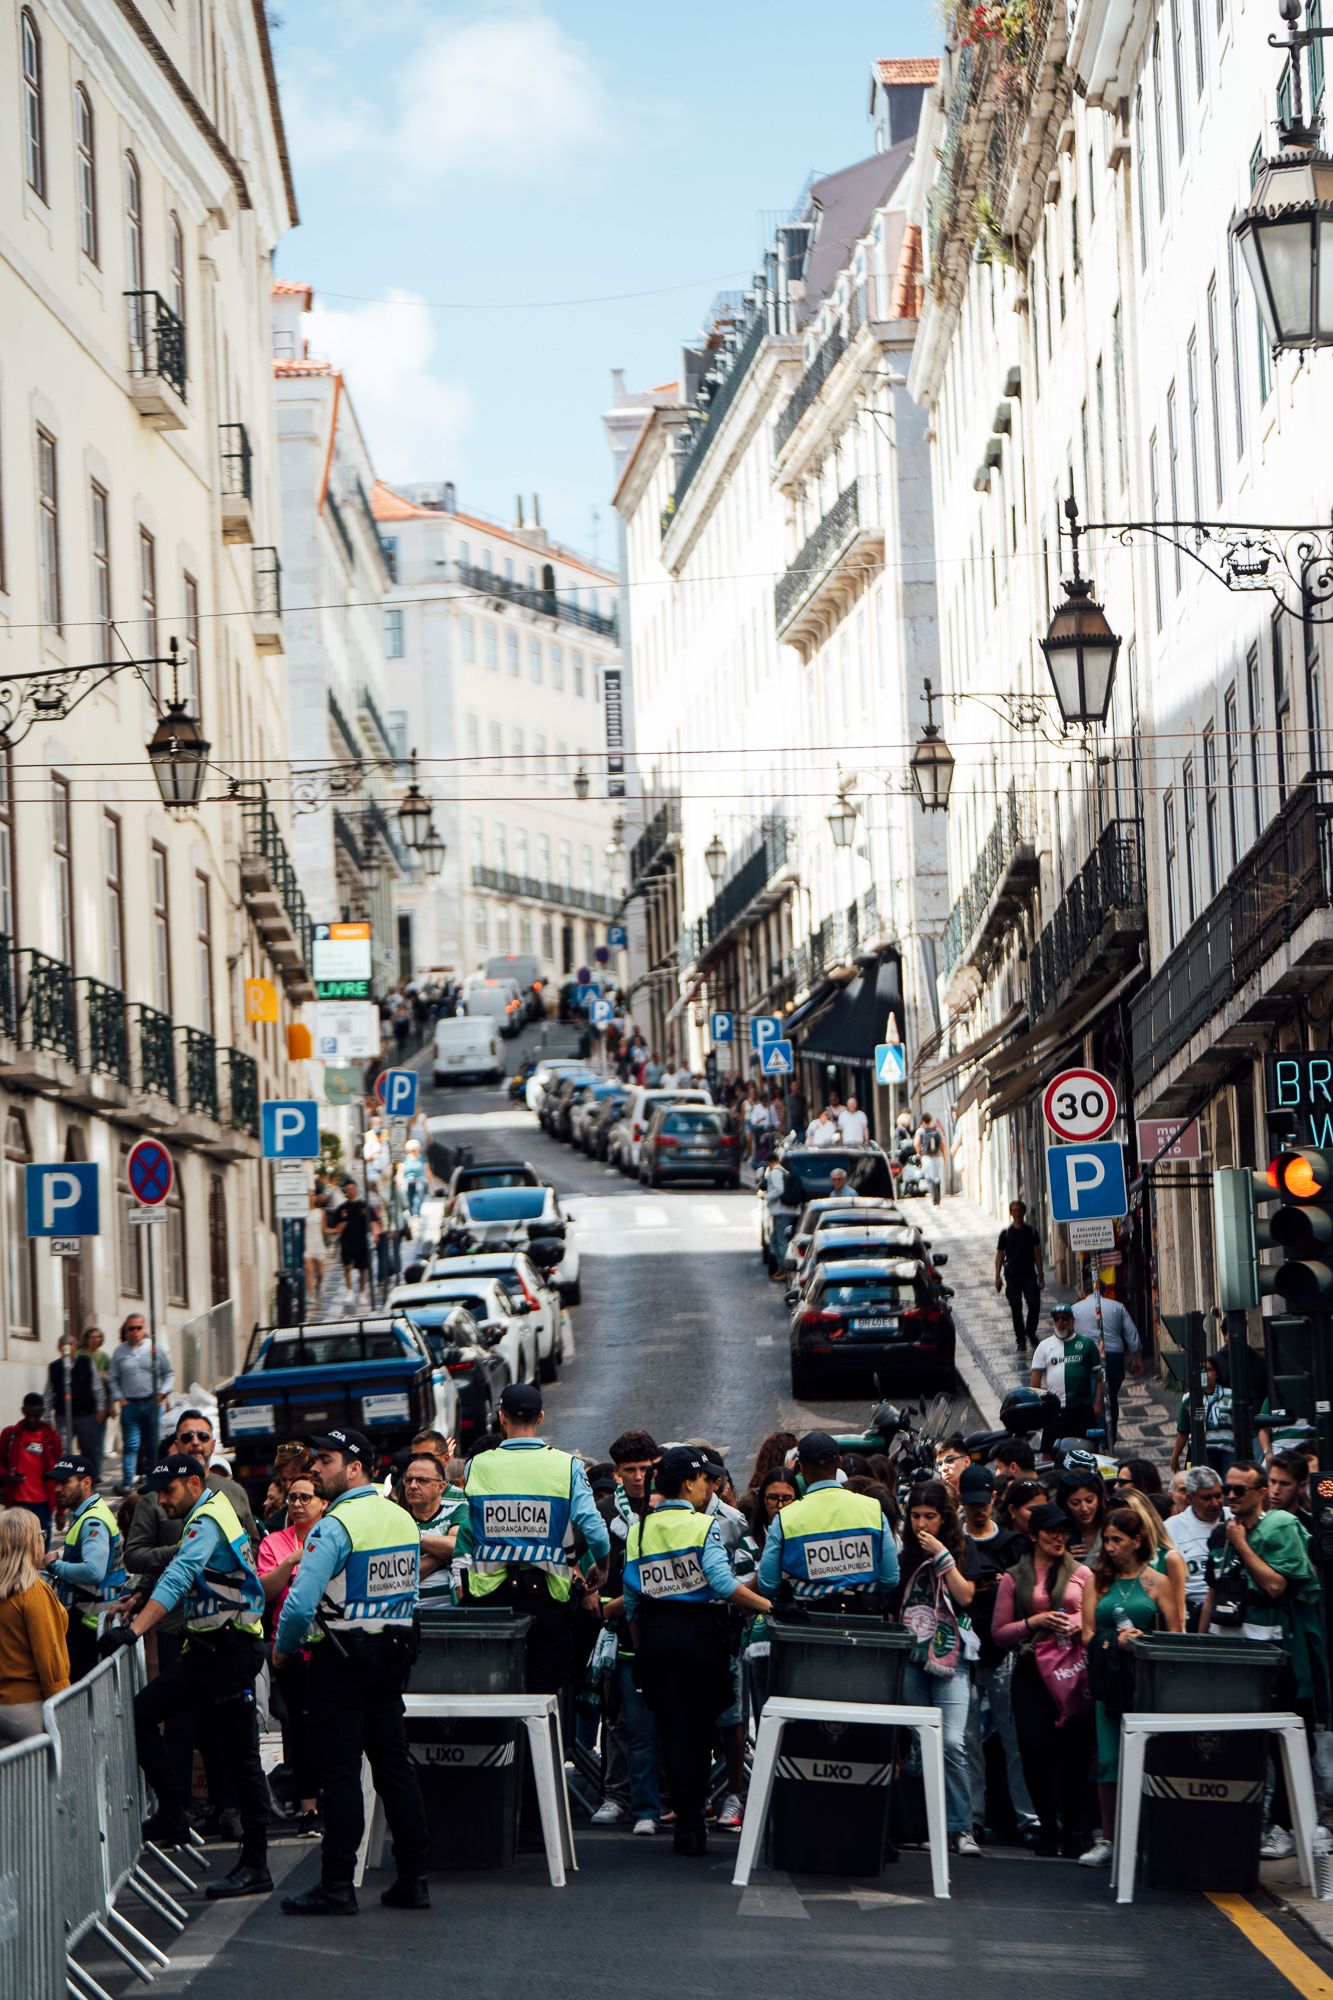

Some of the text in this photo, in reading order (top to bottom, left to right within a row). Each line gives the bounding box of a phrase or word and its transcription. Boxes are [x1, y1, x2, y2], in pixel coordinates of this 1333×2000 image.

[318, 981, 368, 996] LIVRE
[594, 1000, 610, 1020] P
[715, 1014, 730, 1038] P
[756, 1019, 775, 1042] P
[391, 1074, 412, 1111] P
[1056, 1090, 1104, 1120] 30
[274, 1107, 306, 1152] P
[1066, 1153, 1105, 1211] P
[42, 1172, 82, 1228] P
[53, 1241, 79, 1252] CML
[485, 1502, 548, 1524] POLÍCIA
[486, 1525, 547, 1534] SEGURANÇA PÚBLICA
[807, 1540, 870, 1565] POLÍCIA
[369, 1553, 416, 1581] POLÍCIA
[810, 1565, 848, 1576] SEGURANÇA
[369, 1581, 401, 1592] SEGURANÇA
[644, 1583, 681, 1595] SEGURANÇA
[425, 1746, 465, 1762] LIXO
[812, 1762, 853, 1780] LIXO
[1188, 1782, 1229, 1798] LIXO
